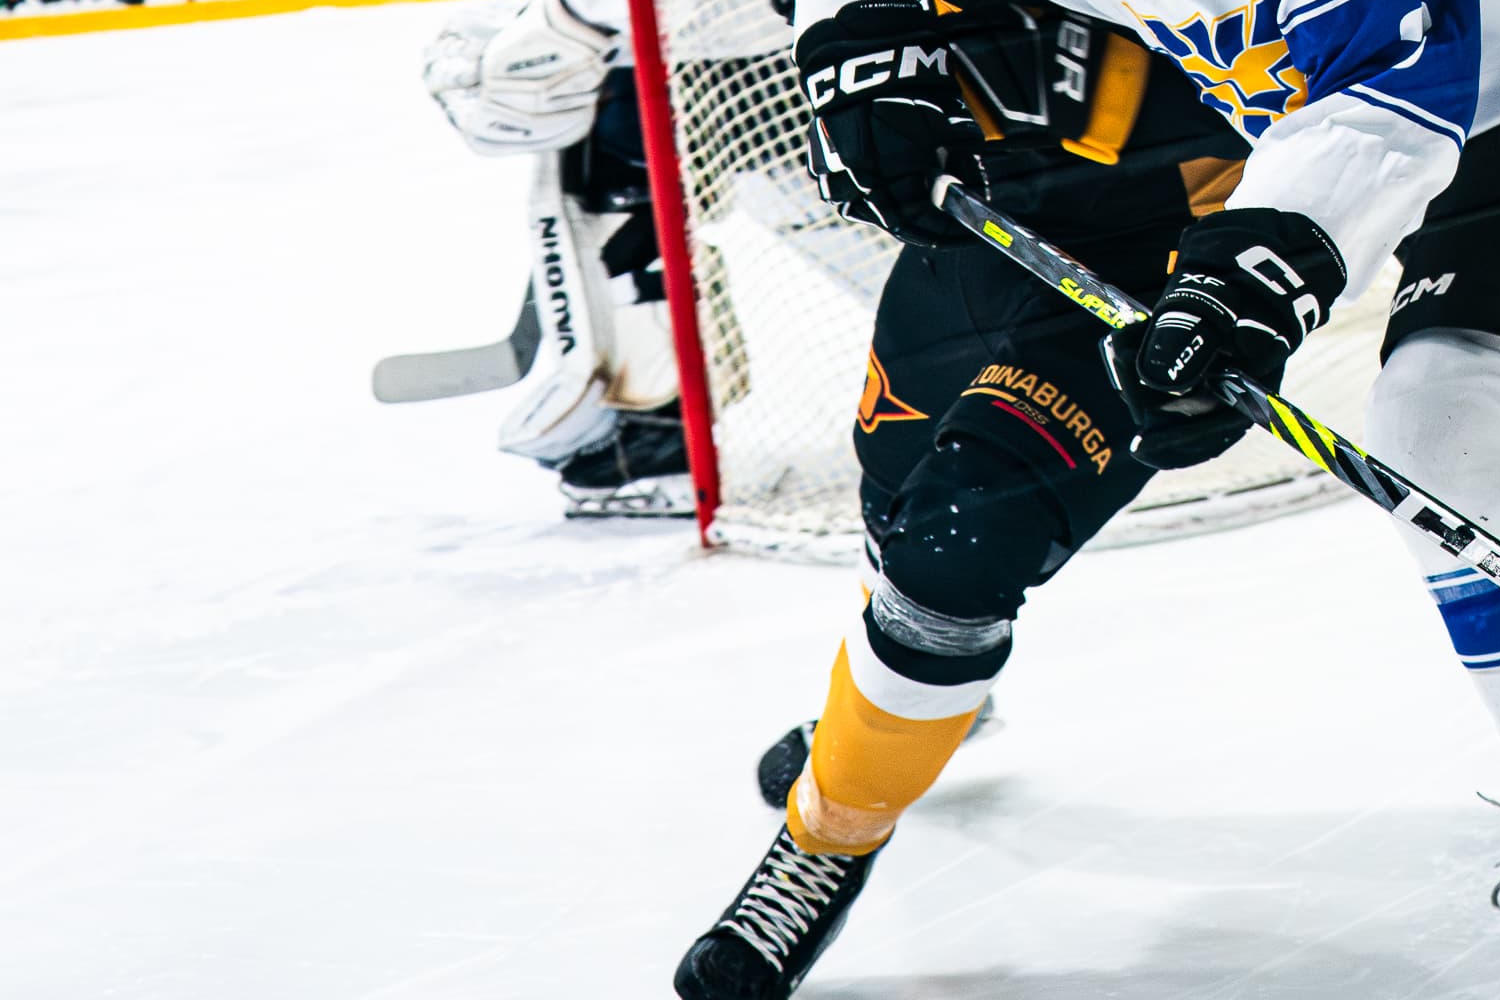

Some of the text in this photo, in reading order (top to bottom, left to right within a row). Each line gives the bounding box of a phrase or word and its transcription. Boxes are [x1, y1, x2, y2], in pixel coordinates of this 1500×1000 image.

[806, 45, 951, 110] CCM
[1390, 272, 1456, 316] CM
[1168, 334, 1205, 382] CCM
[977, 364, 1113, 476] DINABURGA
